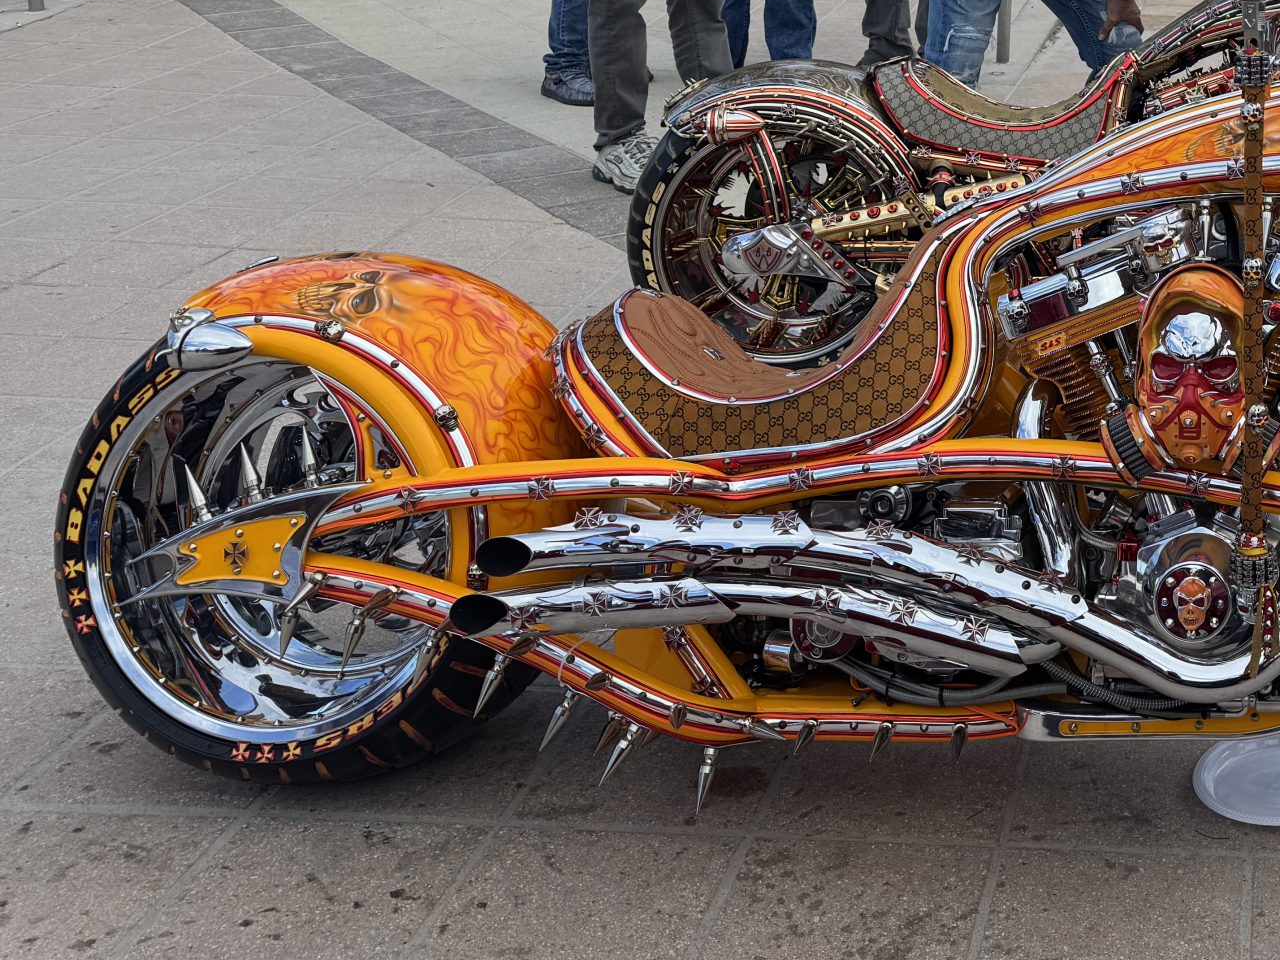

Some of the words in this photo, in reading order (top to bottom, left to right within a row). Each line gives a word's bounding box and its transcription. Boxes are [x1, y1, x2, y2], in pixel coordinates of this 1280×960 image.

[641, 180, 666, 291] ADASS
[1039, 337, 1063, 352] S&S
[65, 367, 184, 545] BADASS
